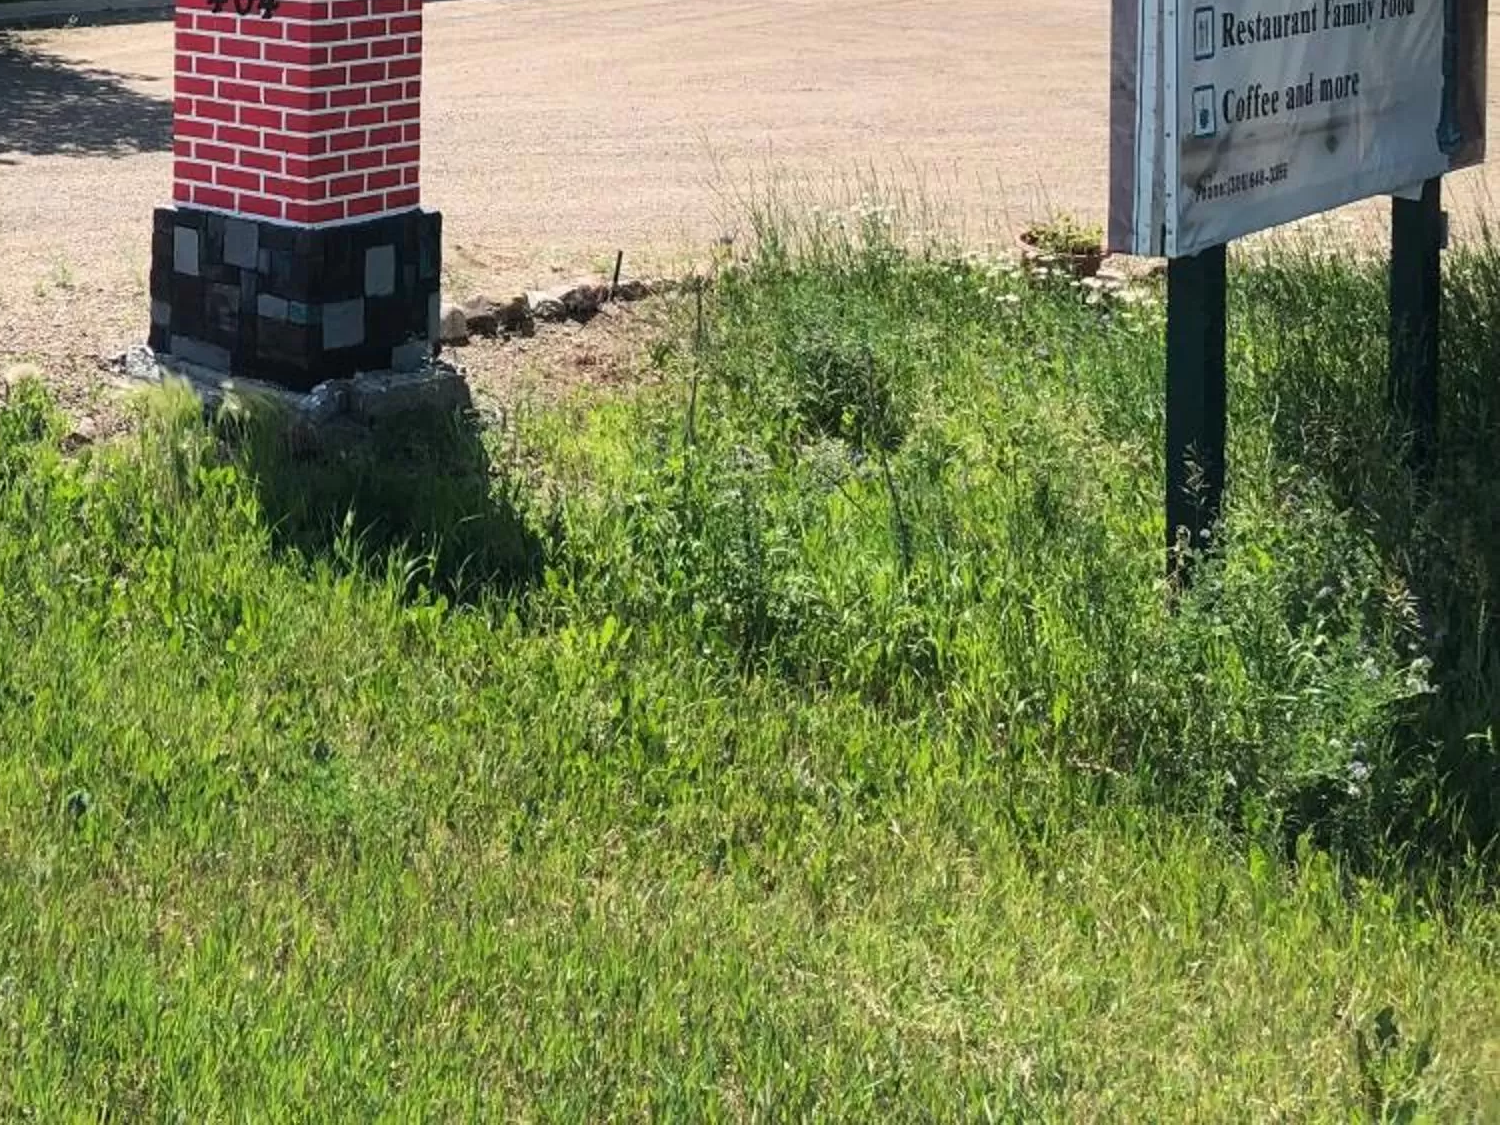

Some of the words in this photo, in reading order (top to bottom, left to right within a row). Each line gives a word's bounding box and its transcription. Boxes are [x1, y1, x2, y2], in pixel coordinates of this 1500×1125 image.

[1221, 2, 1318, 48] Restaurant
[1222, 82, 1280, 124] Coffee
[1285, 72, 1314, 111] and
[1319, 71, 1360, 103] more
